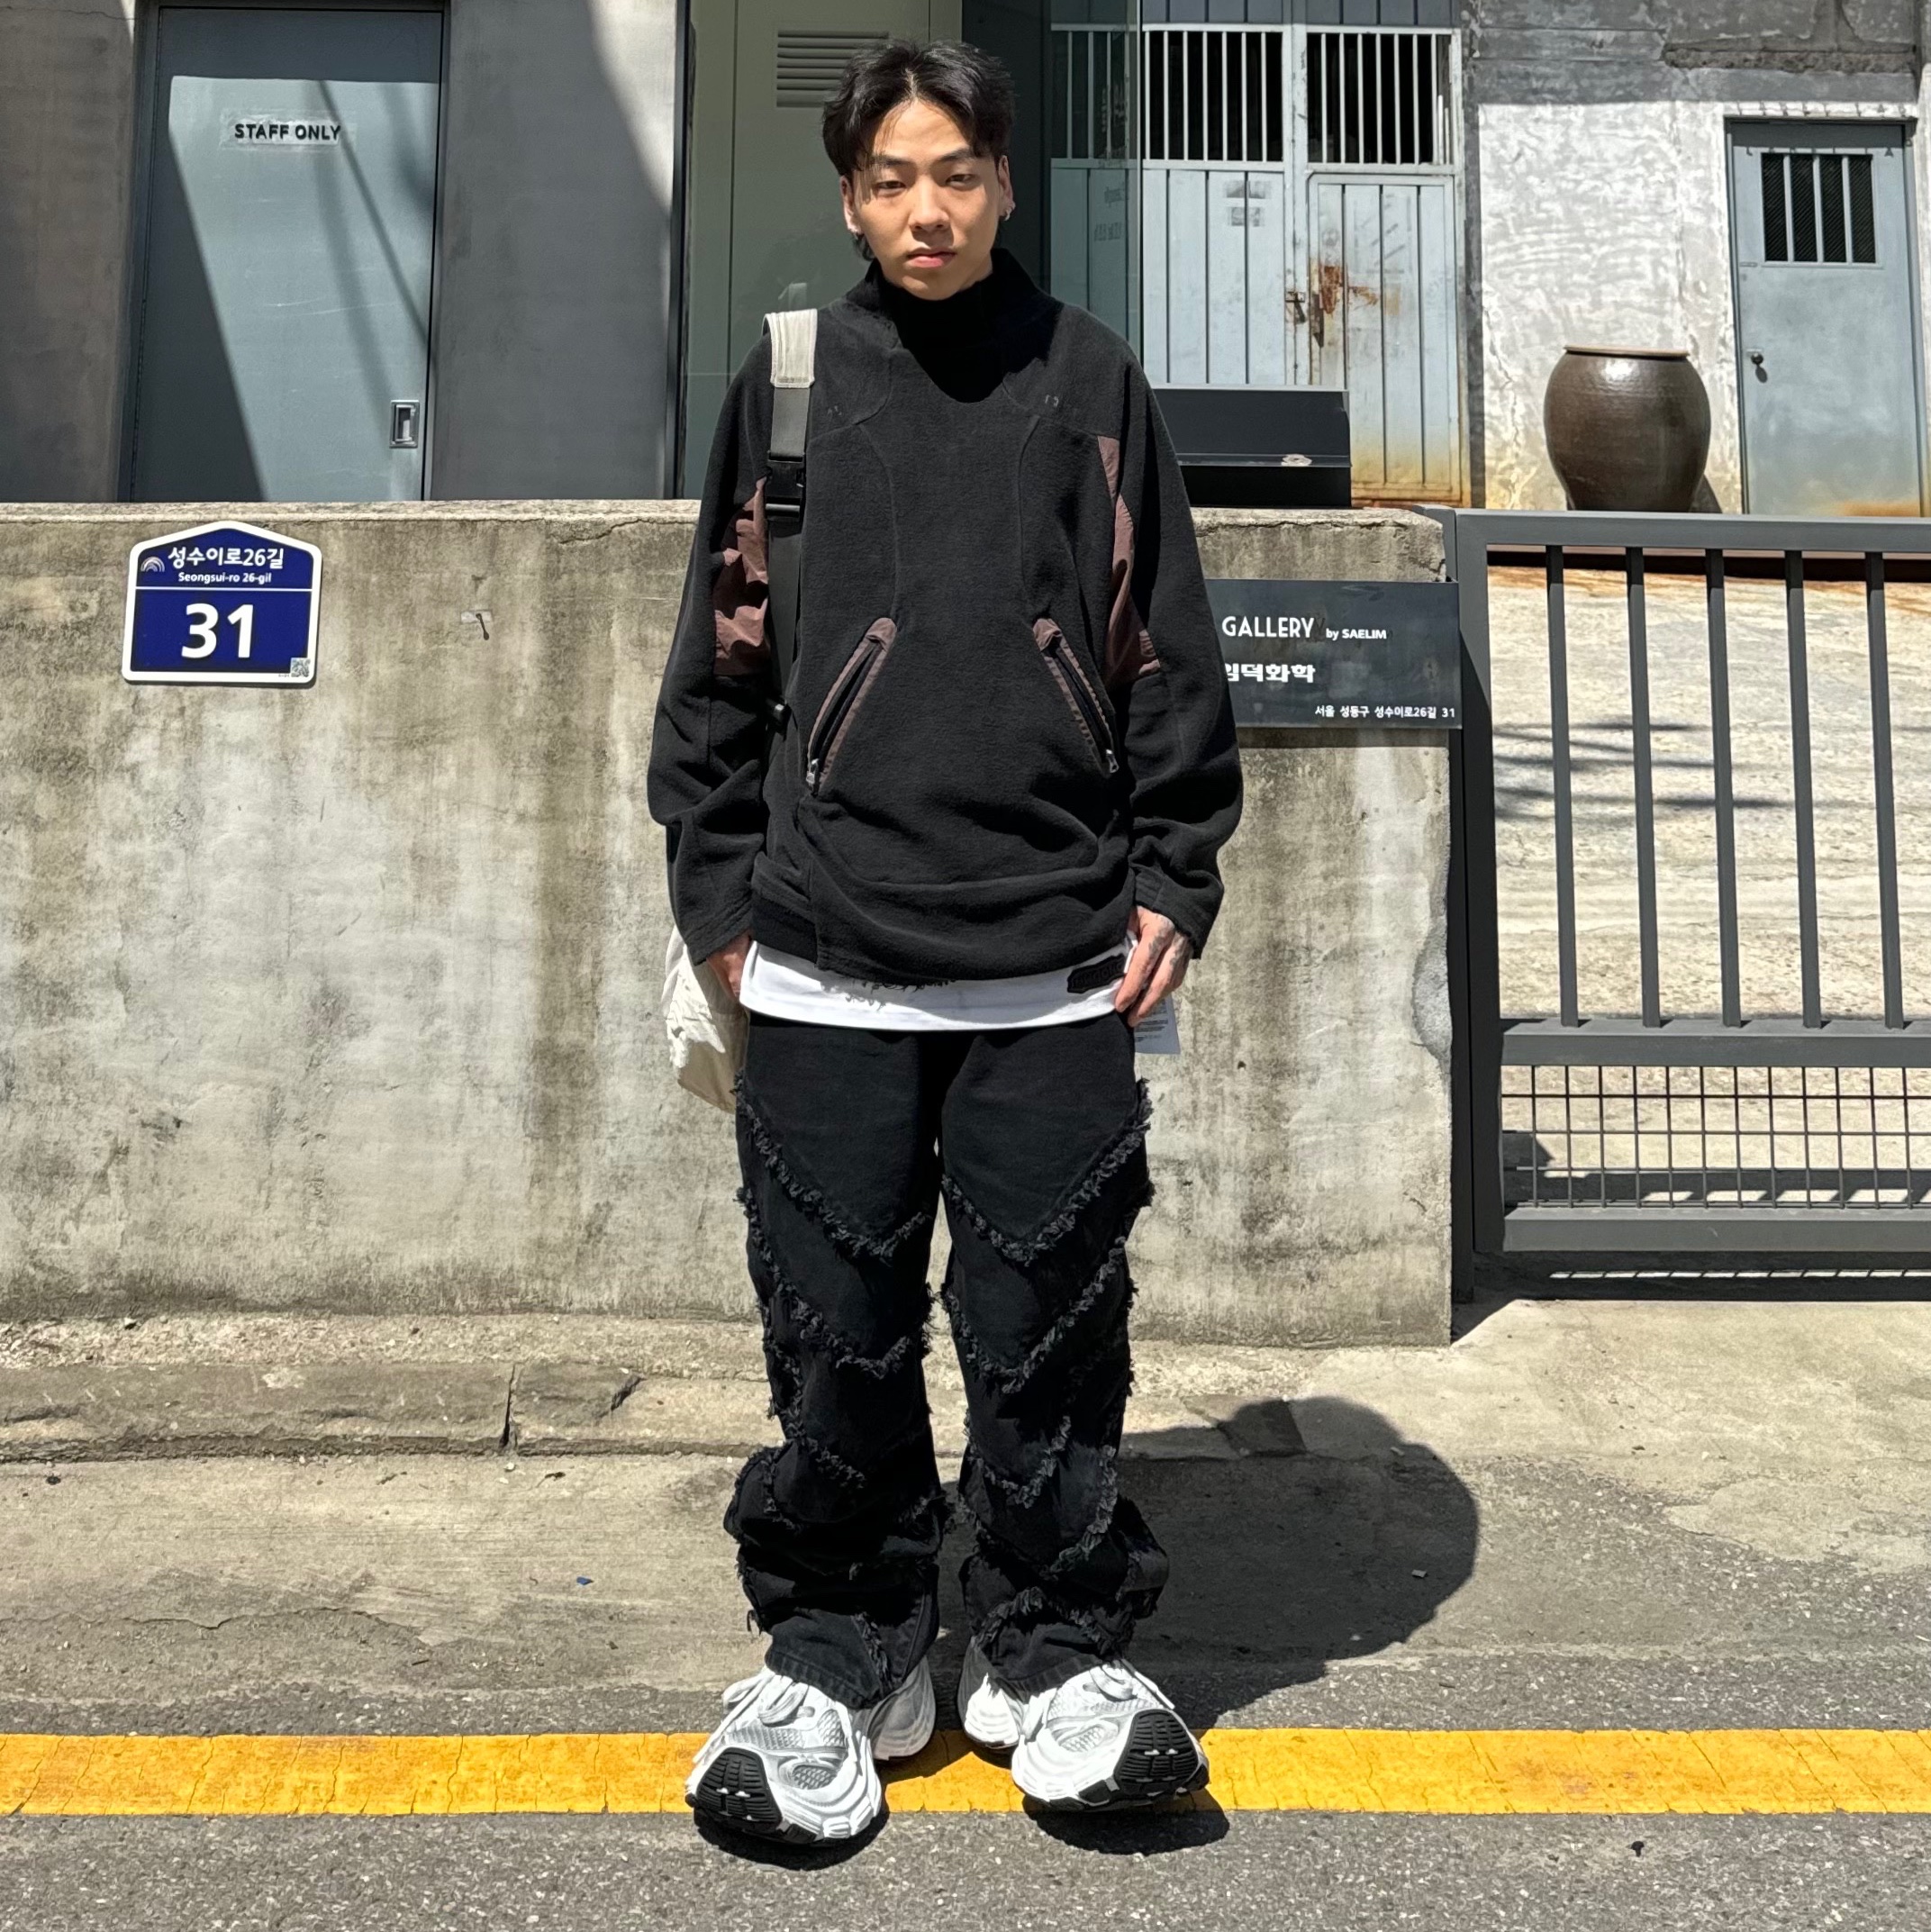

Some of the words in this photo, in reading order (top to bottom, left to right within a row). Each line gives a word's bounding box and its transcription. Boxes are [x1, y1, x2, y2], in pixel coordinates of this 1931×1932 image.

[234, 123, 289, 140] STAFF
[295, 124, 340, 141] ONLY
[168, 547, 284, 569] 성수이로26길
[178, 572, 240, 585] Seongsui-ro
[242, 573, 272, 585] 26-gil
[181, 603, 254, 659] 31
[1221, 616, 1314, 639] GALLERY
[1326, 628, 1338, 641] by
[1342, 629, 1387, 639] SAELIM
[1315, 705, 1335, 718] 서울
[1339, 705, 1370, 719] 성동구
[1374, 706, 1437, 719] 성수이로26길
[1442, 707, 1455, 718] 31
